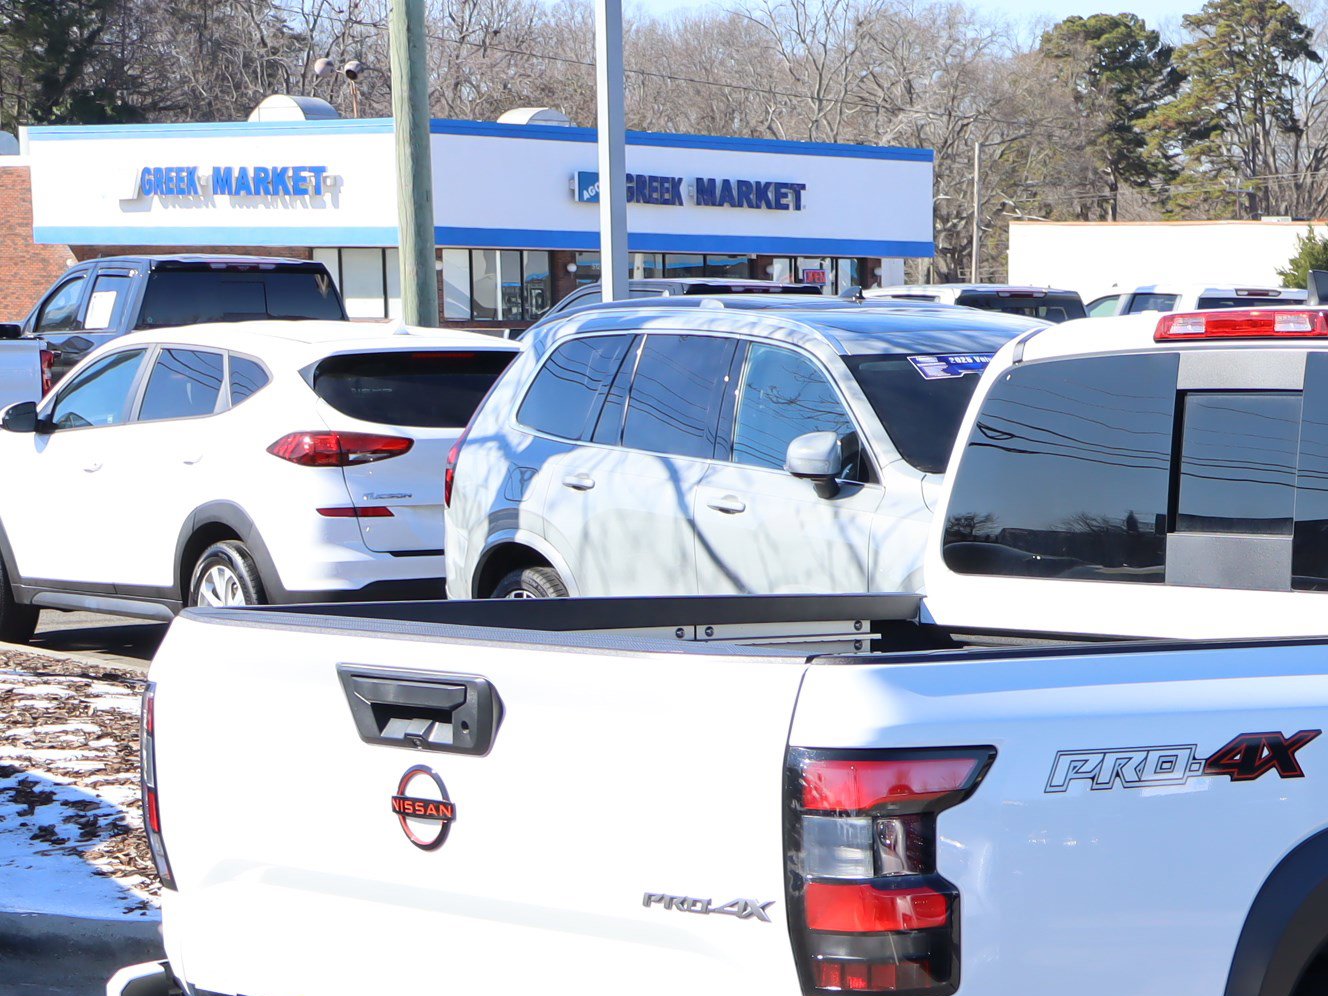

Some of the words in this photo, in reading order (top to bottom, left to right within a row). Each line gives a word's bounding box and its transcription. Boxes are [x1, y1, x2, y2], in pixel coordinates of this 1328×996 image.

[140, 166, 202, 196] GREEK
[211, 165, 328, 196] MARKET
[625, 173, 684, 206] GREEK
[695, 176, 807, 211] MARKET
[392, 799, 452, 817] NISSAN
